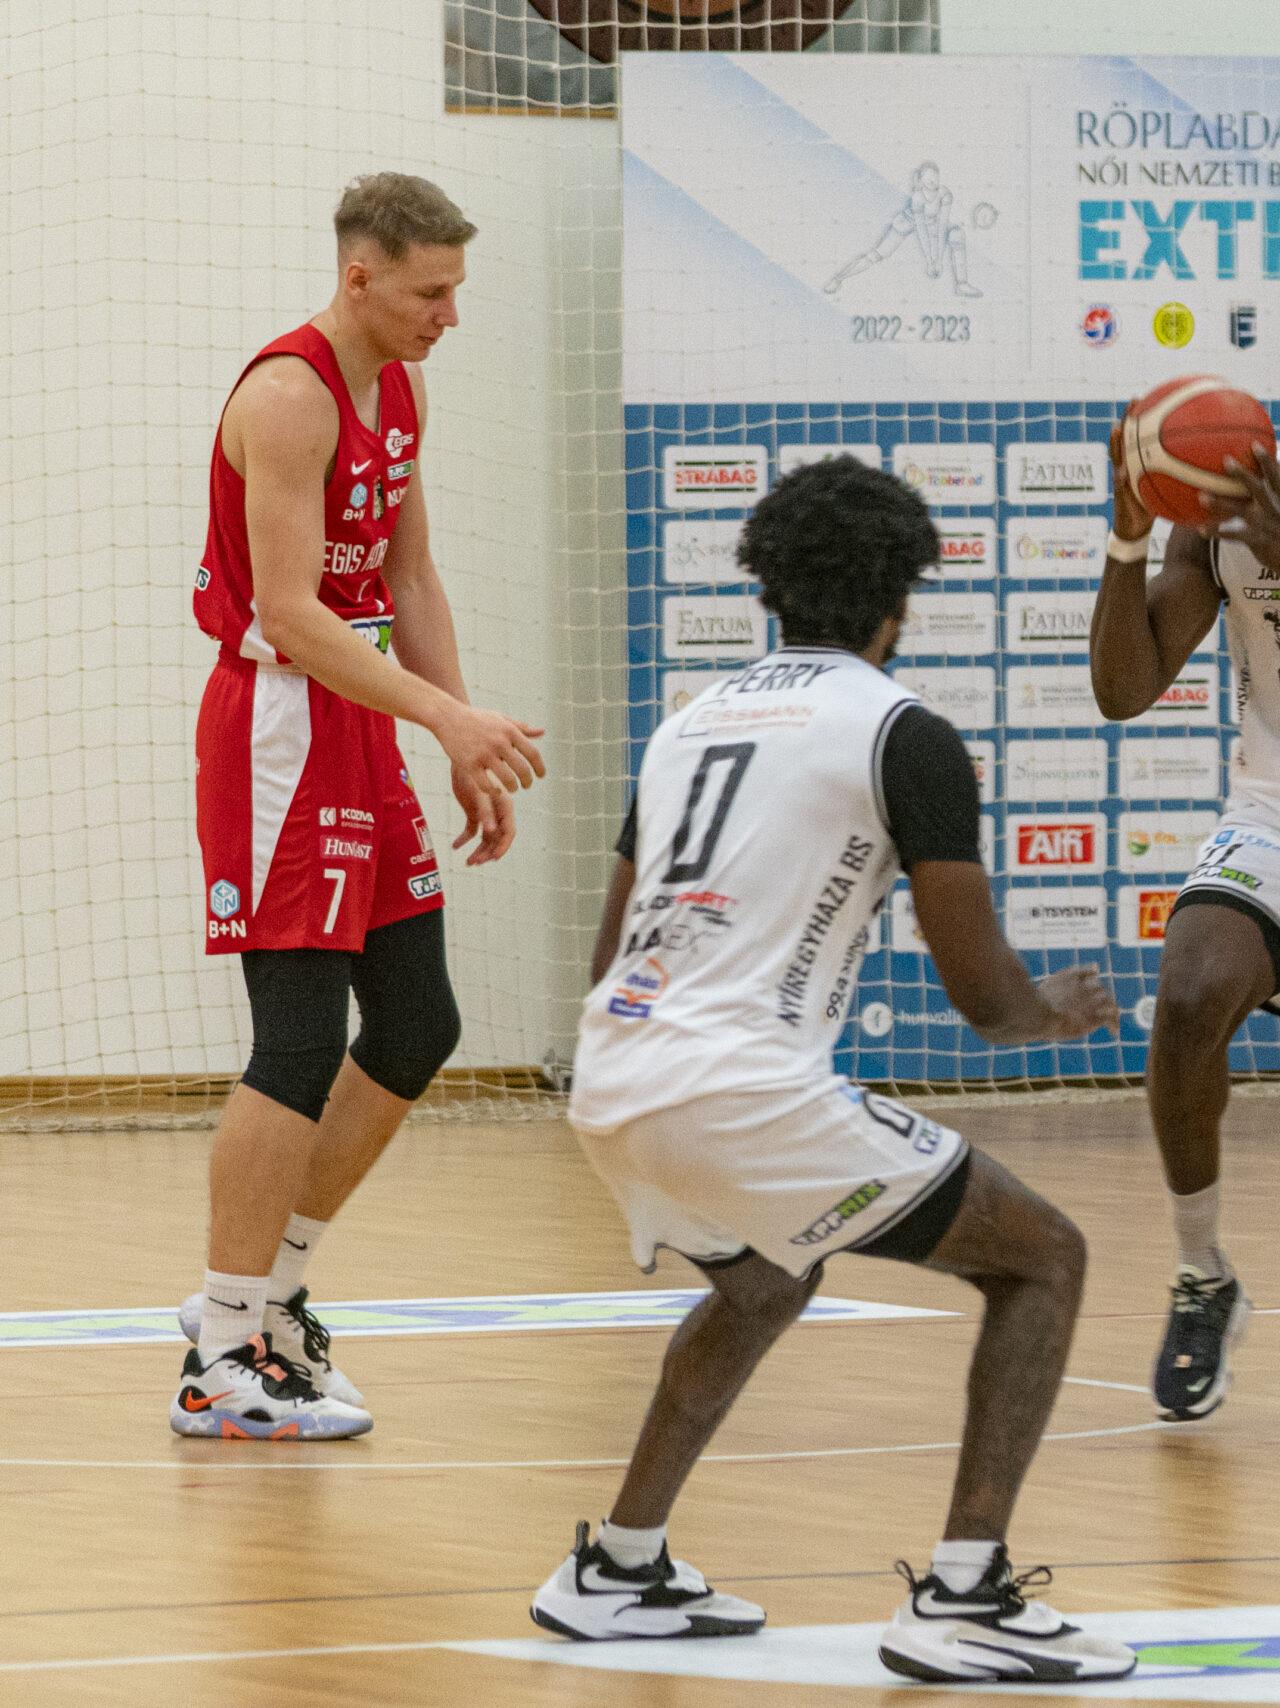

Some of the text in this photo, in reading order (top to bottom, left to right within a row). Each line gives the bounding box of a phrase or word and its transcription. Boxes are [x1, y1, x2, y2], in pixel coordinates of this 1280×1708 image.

[1139, 161, 1259, 187] NEMZETI
[676, 468, 758, 486] STRABAG
[1021, 457, 1094, 481] FATUM
[678, 610, 753, 632] FATUM
[323, 868, 347, 934] 7
[209, 920, 247, 938] B+N
